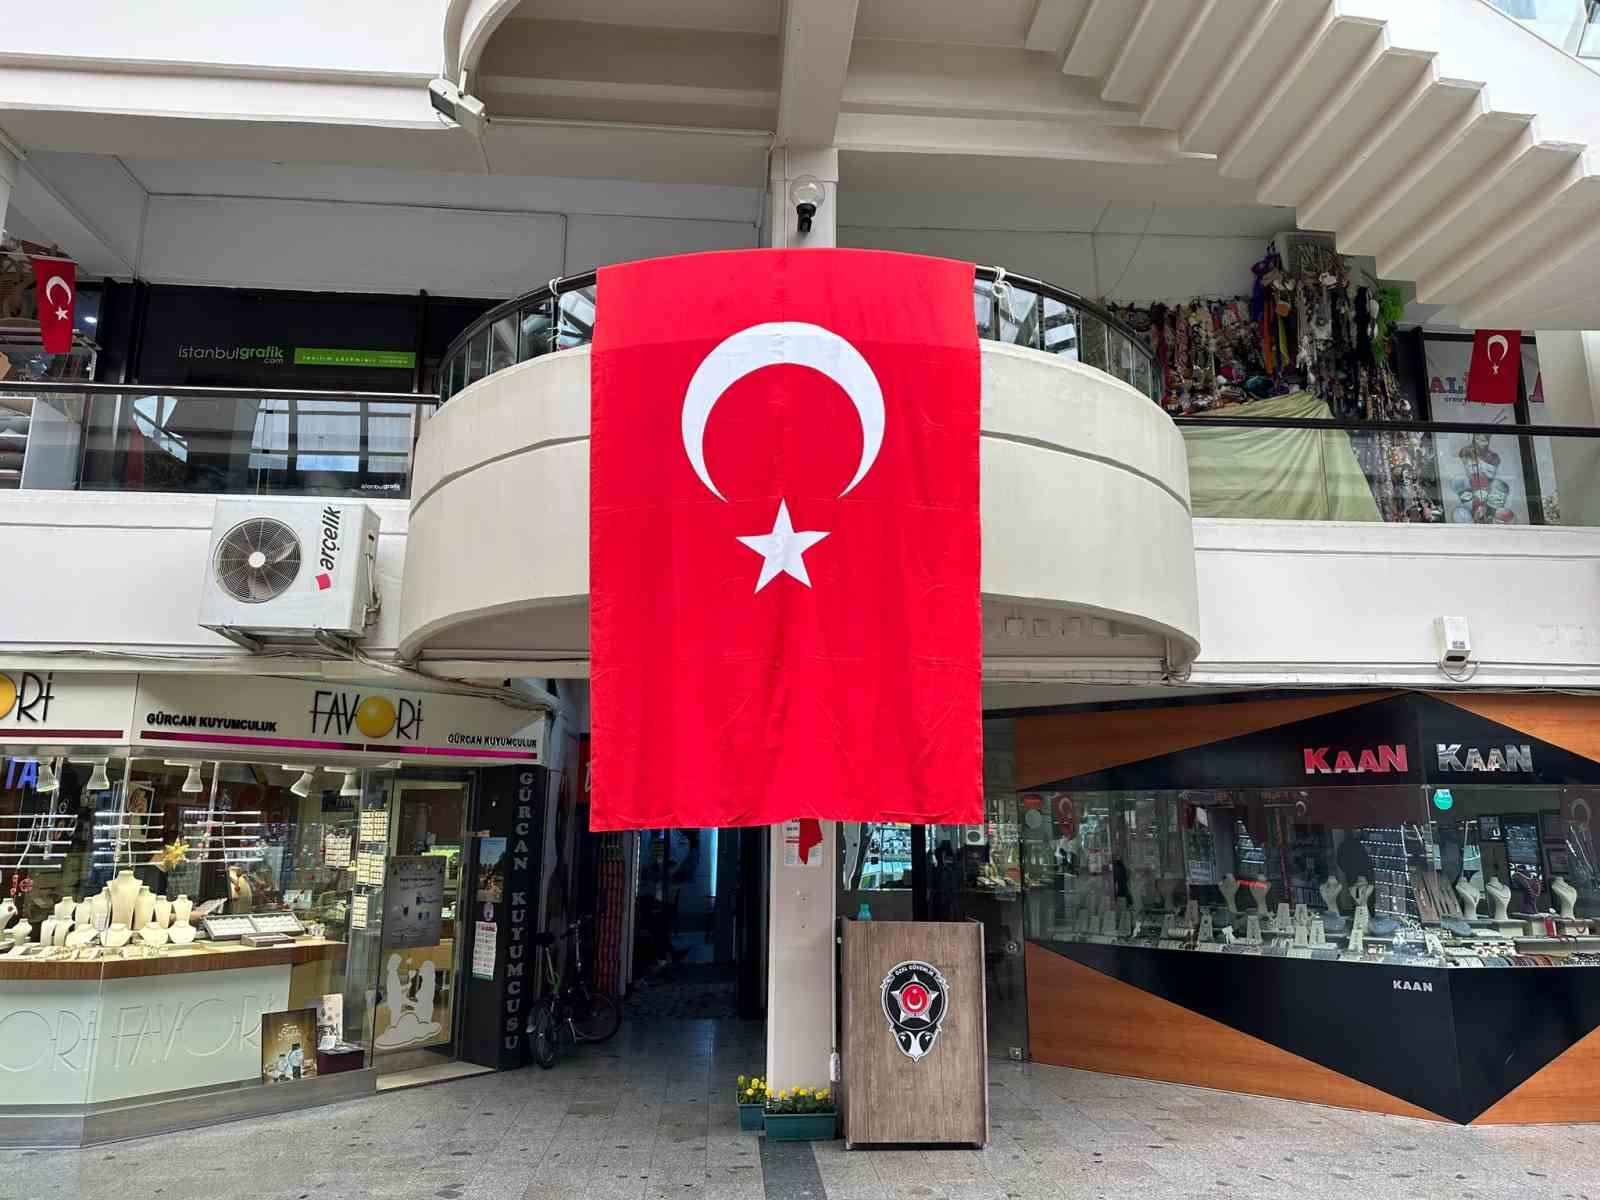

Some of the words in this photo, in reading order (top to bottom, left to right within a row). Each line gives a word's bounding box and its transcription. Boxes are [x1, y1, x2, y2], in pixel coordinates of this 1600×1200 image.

[319, 505, 342, 571] arçelik
[146, 710, 197, 727] GÜRCAN
[198, 717, 277, 732] KUYUMCULUK
[447, 732, 483, 745] GÜRCAN
[484, 736, 537, 749] KUYUMCULUK
[1303, 744, 1409, 774] KAAN
[1435, 743, 1534, 772] KAAN
[504, 891, 528, 1050] KUYUMCUSU
[1392, 980, 1433, 992] KAAN
